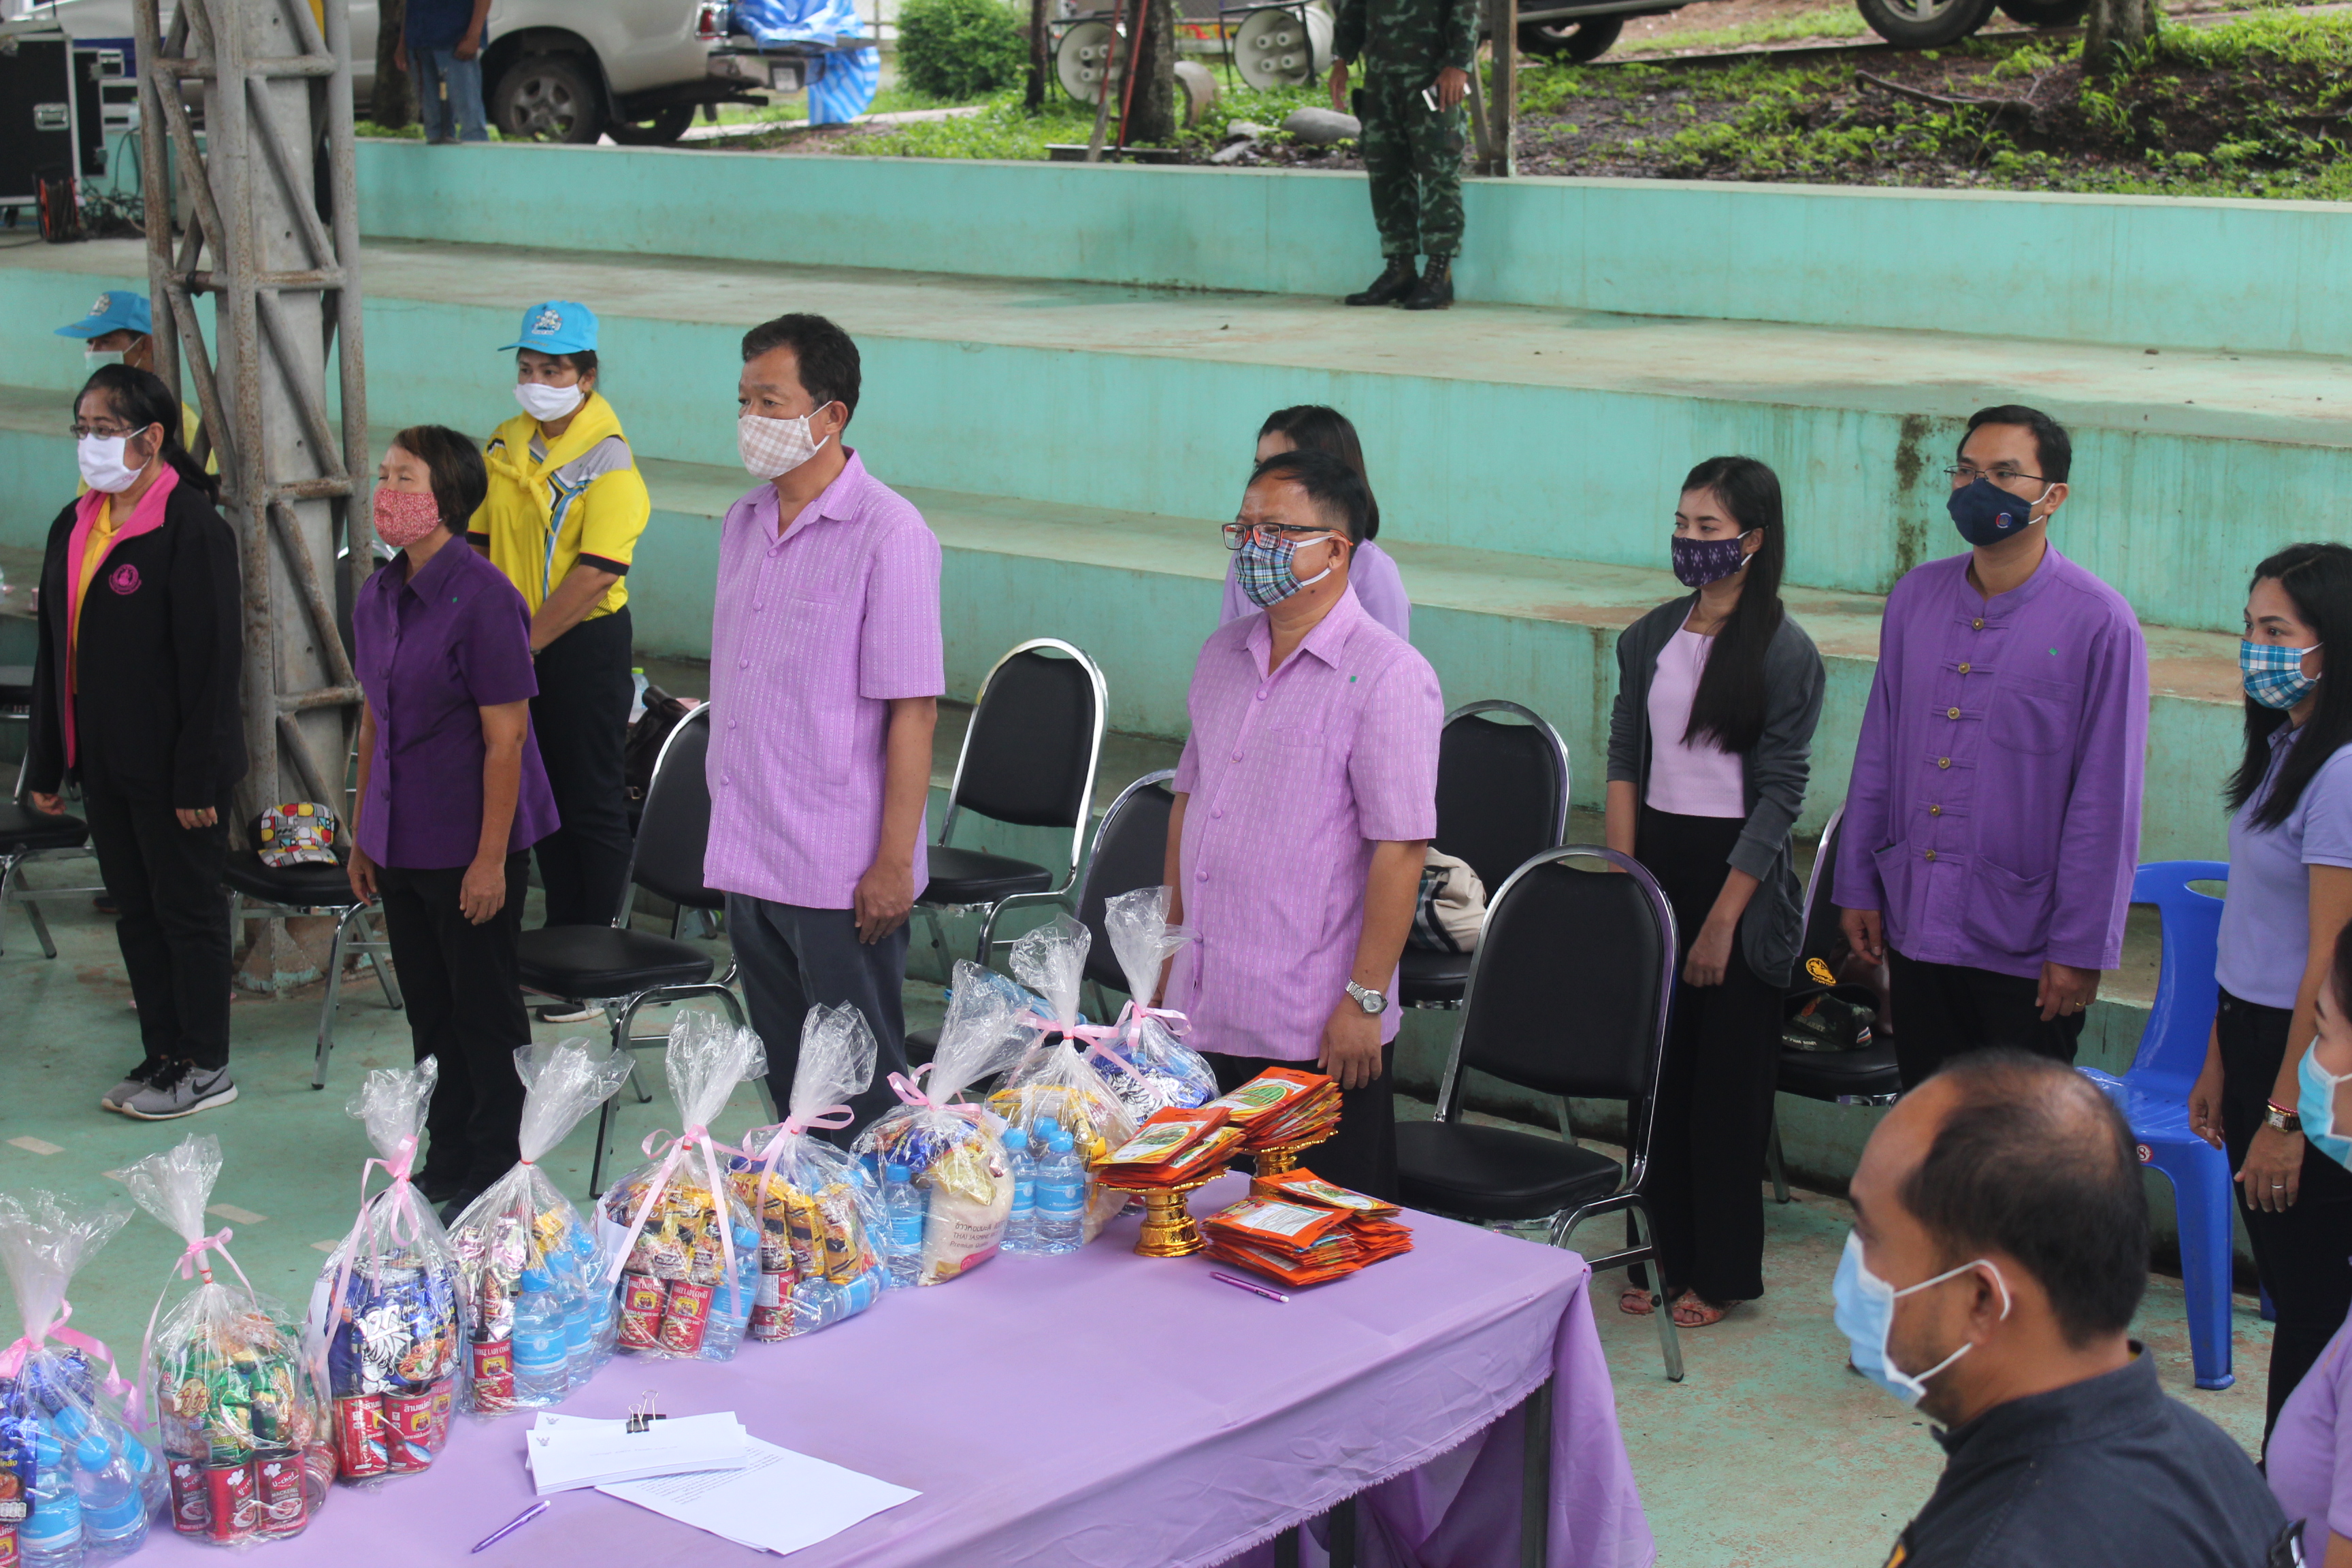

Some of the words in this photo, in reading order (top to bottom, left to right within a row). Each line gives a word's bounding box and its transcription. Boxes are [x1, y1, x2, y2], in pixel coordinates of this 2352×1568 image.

[684, 1288, 695, 1296] LADY
[695, 1290, 708, 1298] COOKS
[272, 1471, 295, 1487] U-chef
[272, 1488, 298, 1497] MACKEREL
